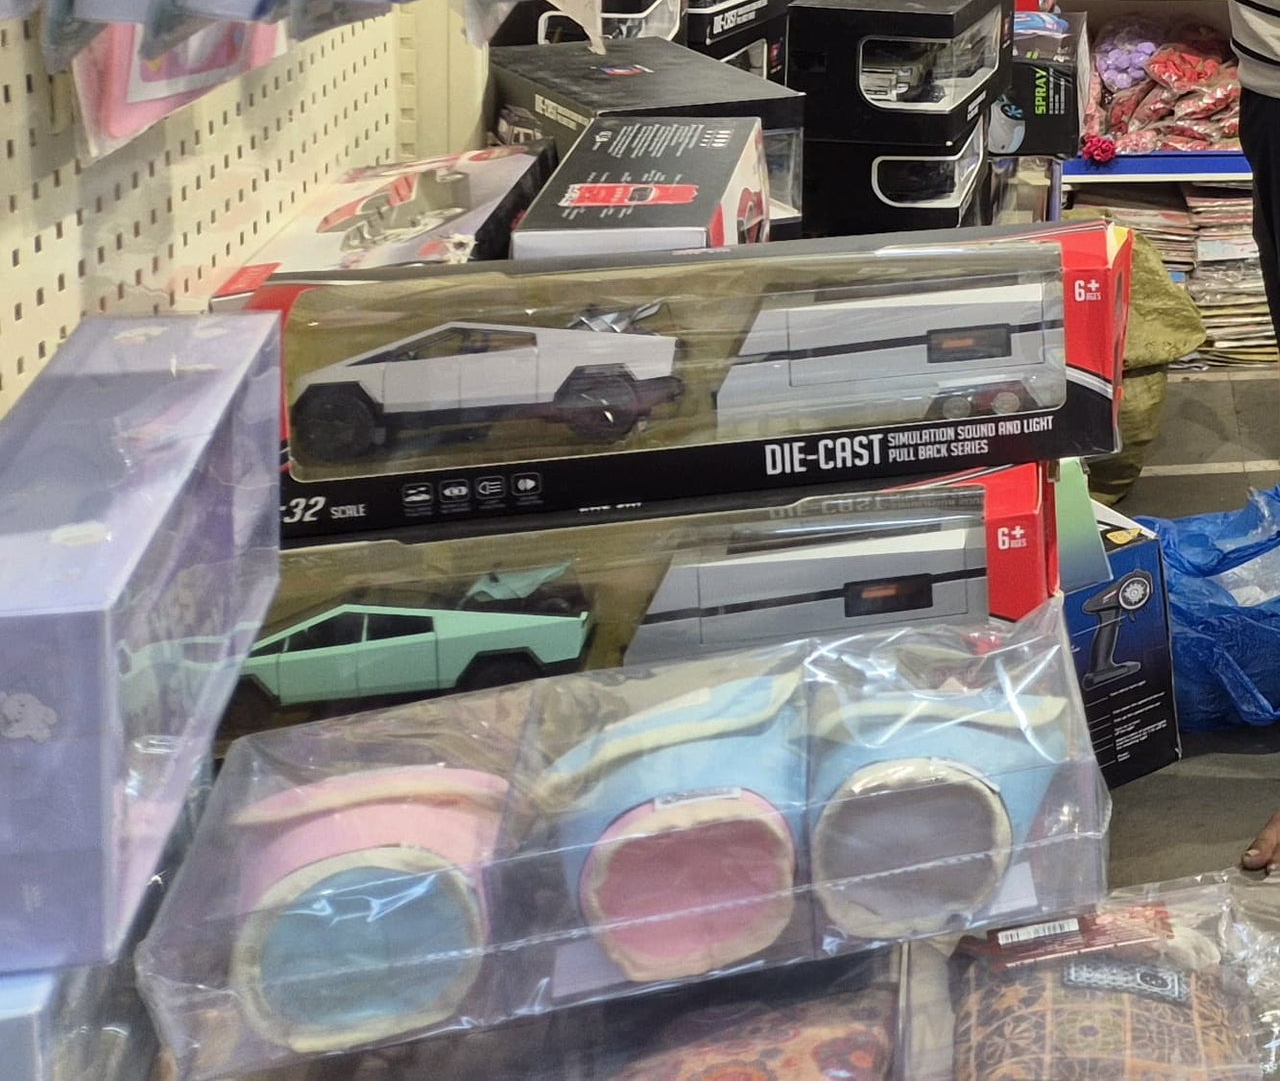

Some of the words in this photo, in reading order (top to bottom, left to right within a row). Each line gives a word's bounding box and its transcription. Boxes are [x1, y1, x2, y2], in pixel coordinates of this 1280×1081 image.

[1035, 68, 1047, 115] SPRAY
[1074, 279, 1100, 301] 6+
[887, 427, 955, 447] SIMULATION
[957, 423, 996, 440] SOUND
[997, 420, 1020, 435] AND
[1023, 416, 1054, 433] LIGHT
[764, 434, 885, 476] DIE-CAST
[888, 448, 917, 463] PULL
[917, 445, 949, 459] BACK
[950, 440, 988, 456] SERIES
[330, 504, 367, 519] SCALE
[997, 525, 1025, 550] 6+
